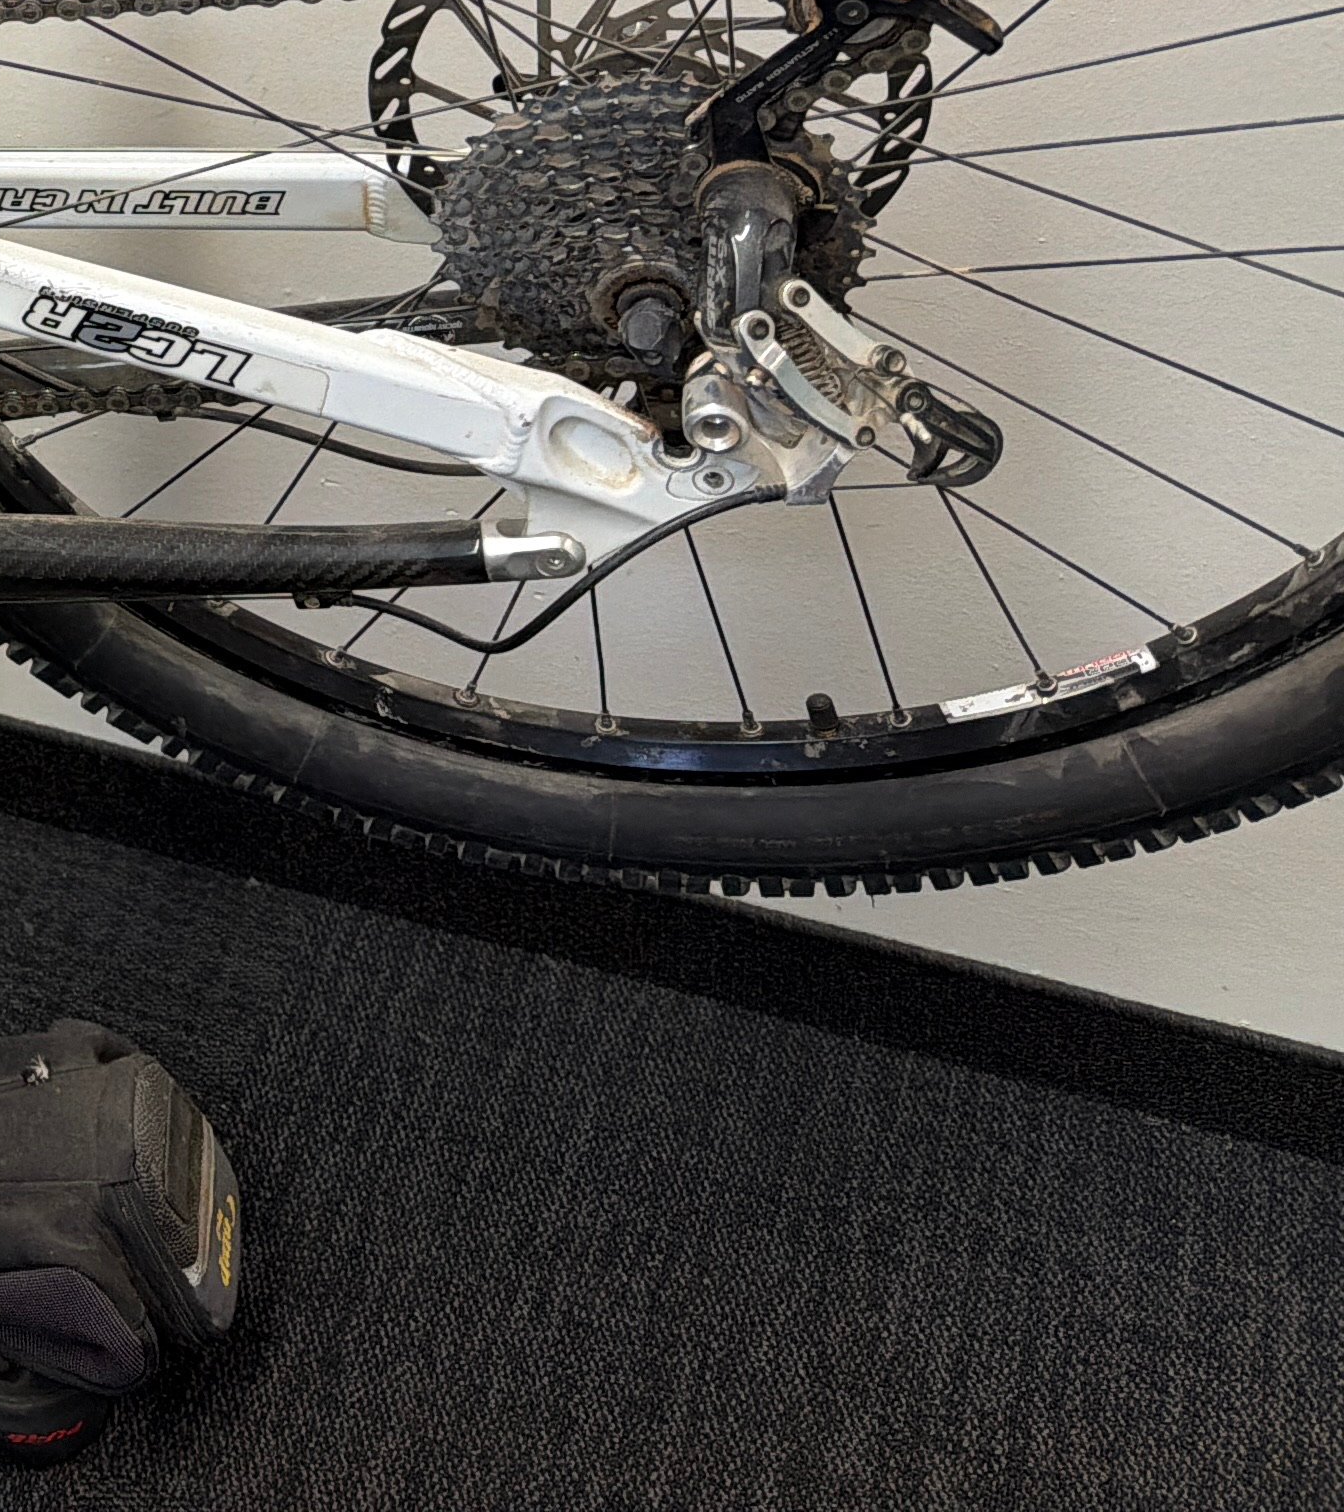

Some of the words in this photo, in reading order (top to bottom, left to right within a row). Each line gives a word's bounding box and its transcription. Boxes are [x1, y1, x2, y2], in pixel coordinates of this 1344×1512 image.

[69, 189, 128, 214] IN
[134, 190, 286, 215] BUILT
[23, 294, 252, 387] LC2R
